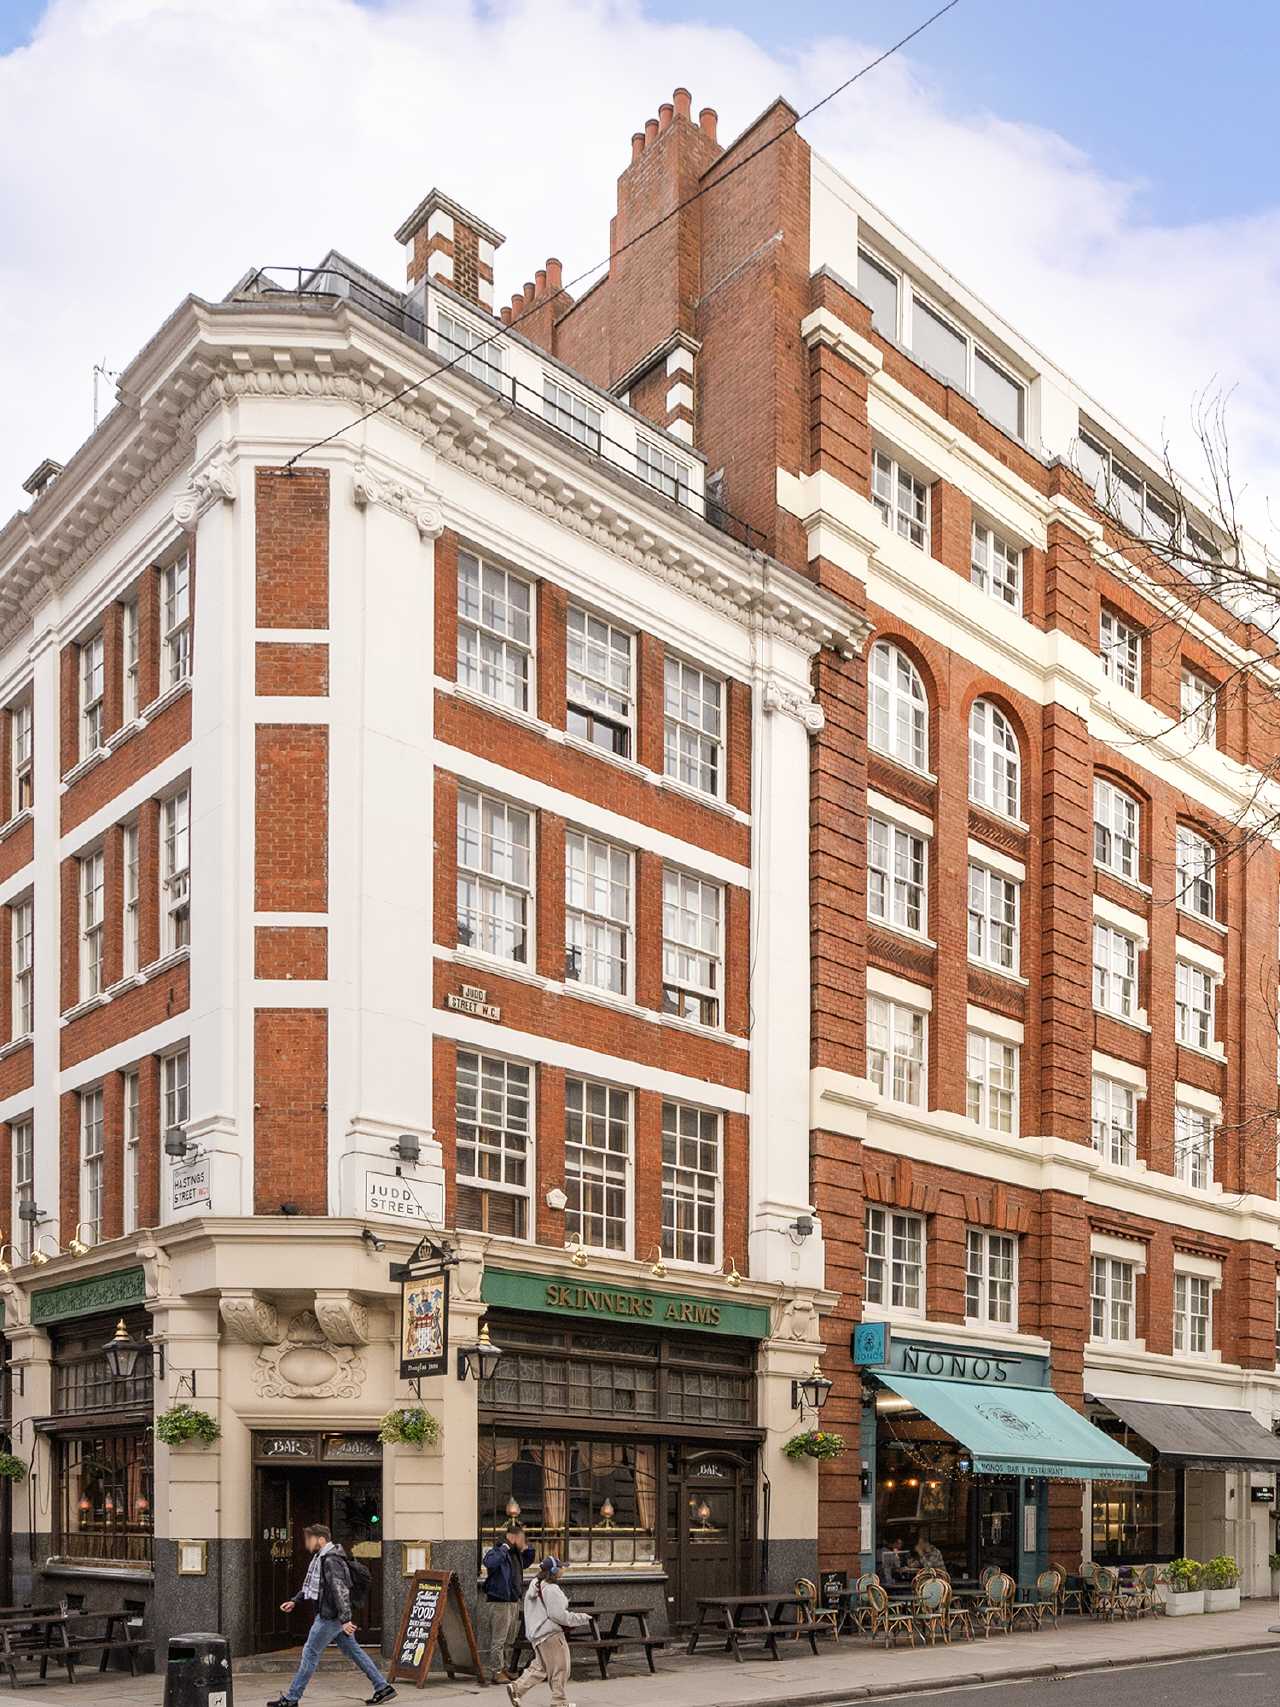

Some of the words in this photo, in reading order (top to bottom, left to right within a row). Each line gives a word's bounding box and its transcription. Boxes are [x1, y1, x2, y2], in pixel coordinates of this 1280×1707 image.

[465, 988, 484, 1001] JUDD
[452, 997, 478, 1012] STREET
[174, 1172, 205, 1189] HASTINGS
[174, 1188, 196, 1204] STREET
[370, 1184, 412, 1201] JUDD
[370, 1198, 422, 1216] STREET
[546, 1284, 654, 1317] SKINNERS
[664, 1302, 721, 1326] ARMS
[903, 1347, 1008, 1383] NONOS
[268, 1439, 308, 1457] BAR
[697, 1463, 722, 1477] BAR
[410, 1605, 436, 1620] FOOD
